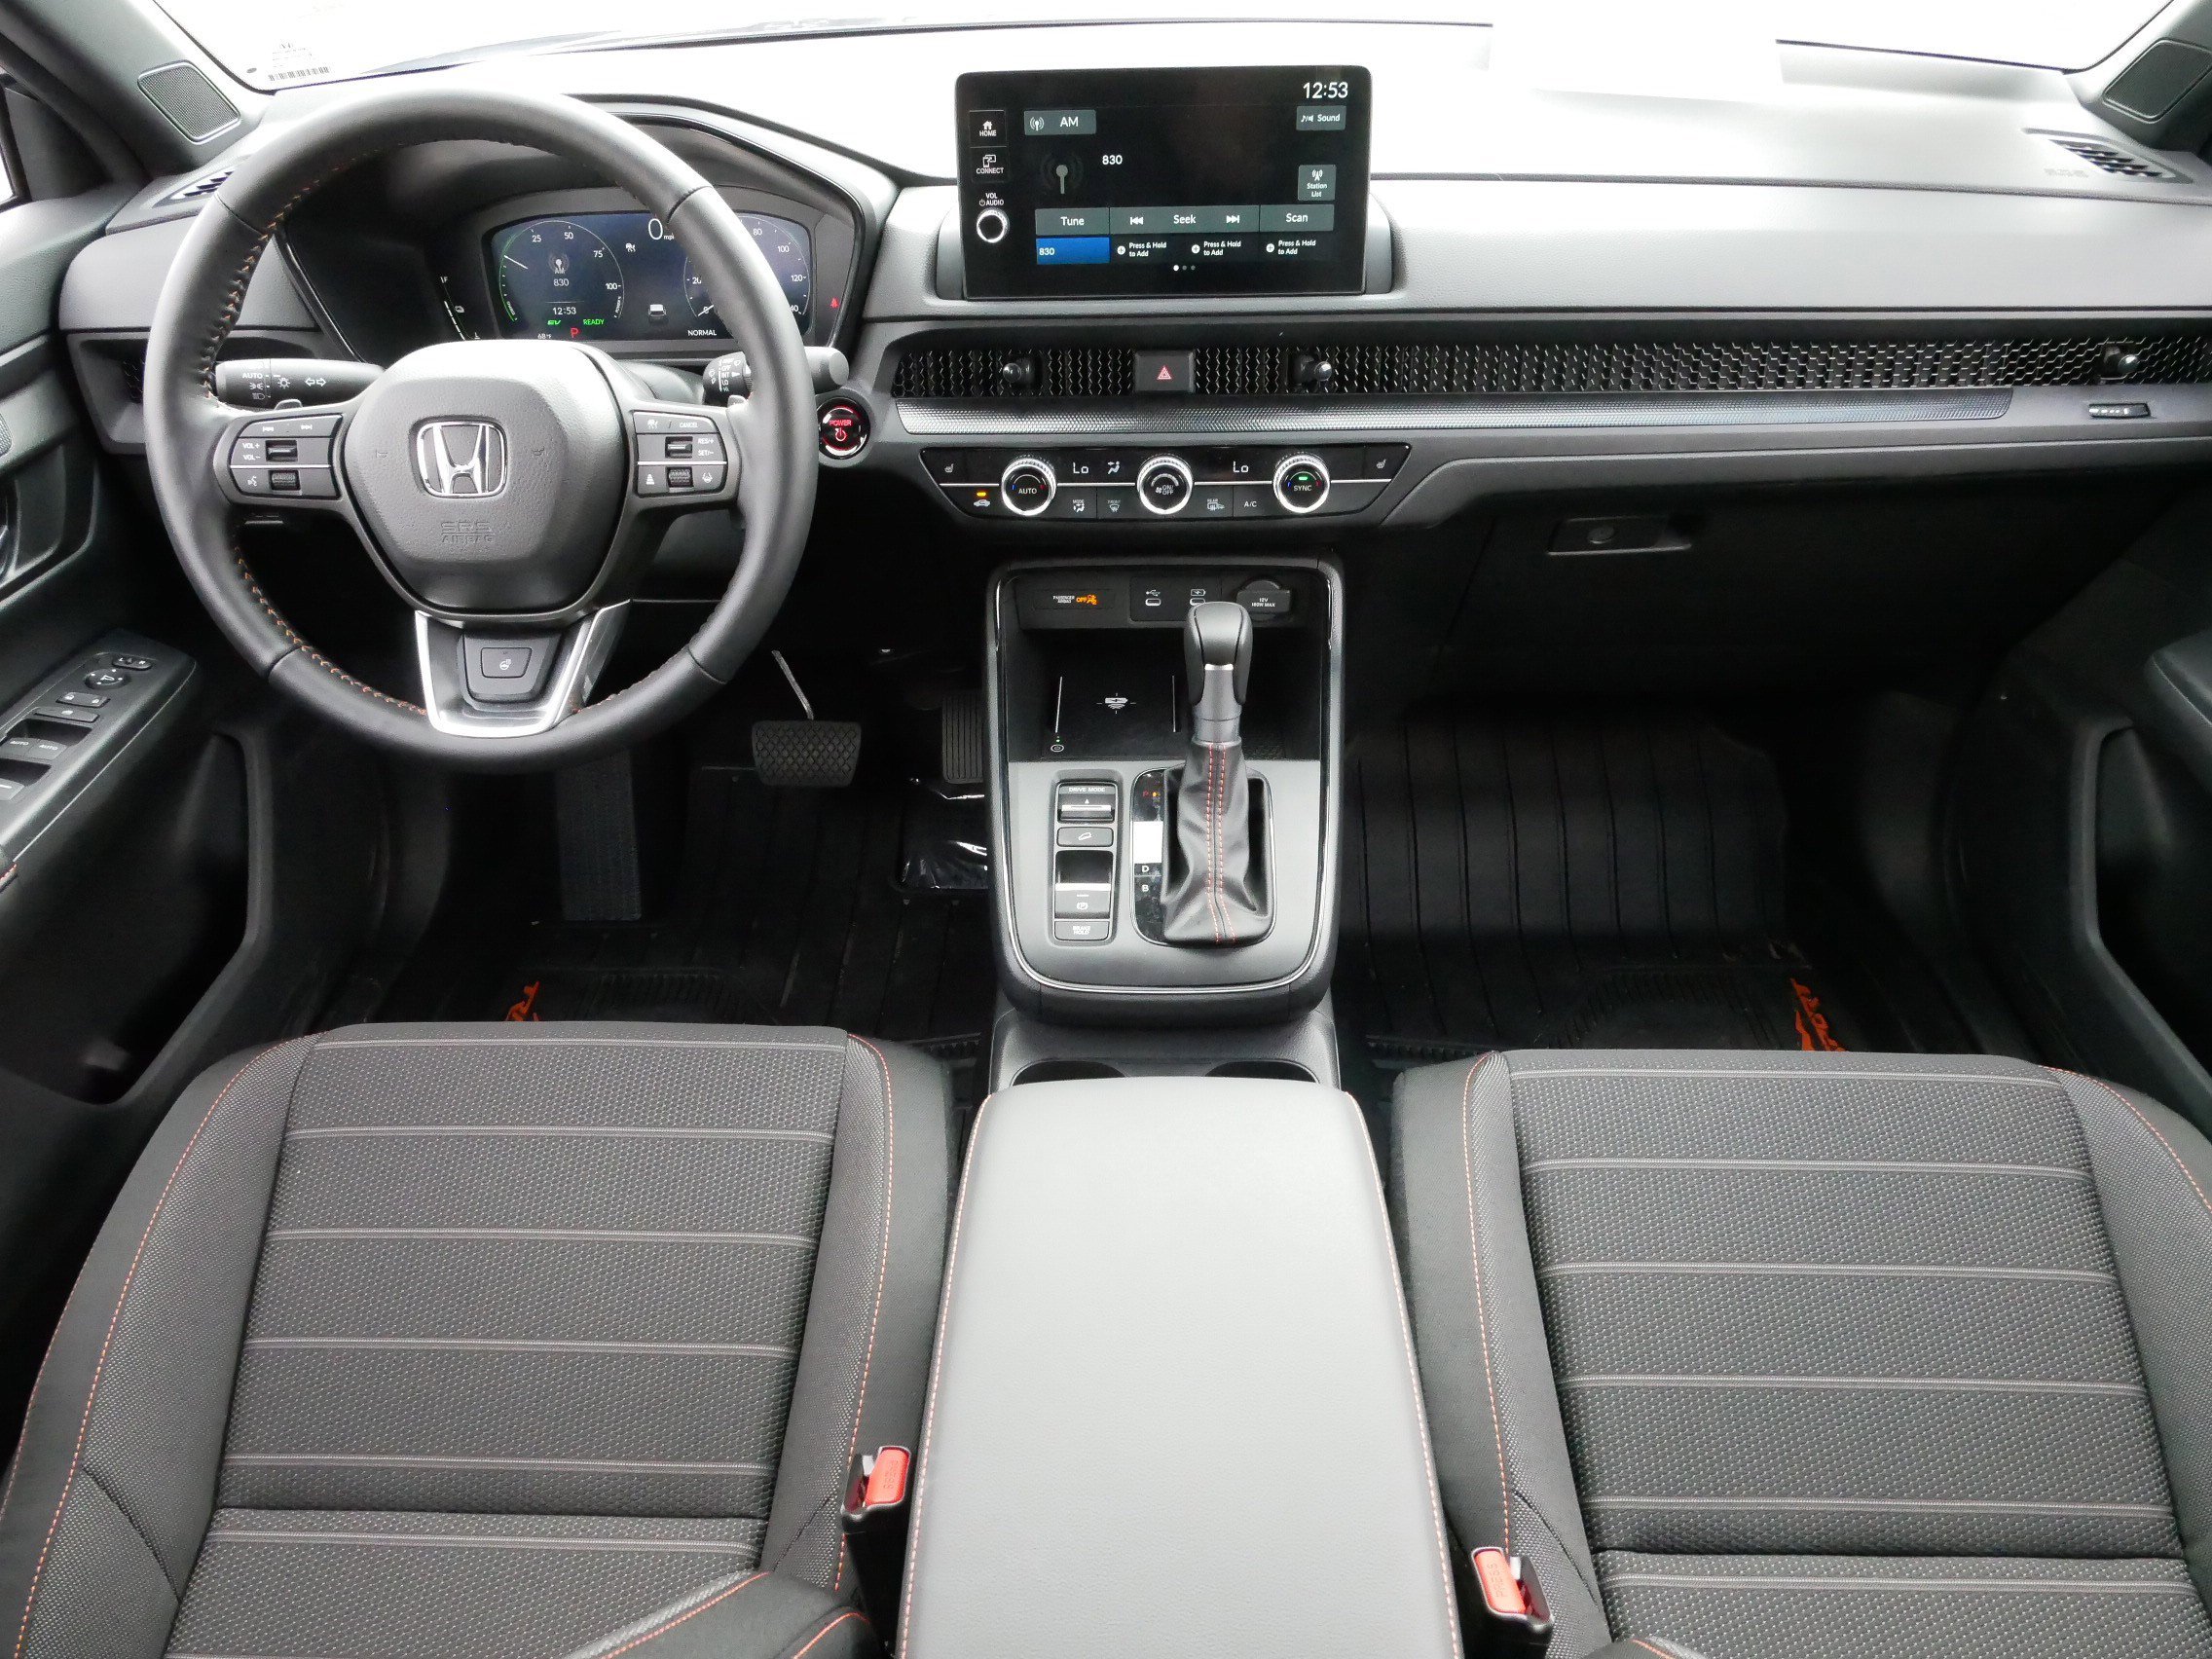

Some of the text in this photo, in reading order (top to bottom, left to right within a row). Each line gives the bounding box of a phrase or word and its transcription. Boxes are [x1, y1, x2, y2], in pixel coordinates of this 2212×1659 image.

[1303, 81, 1348, 99] 12:53
[1060, 116, 1079, 128] AM
[1317, 114, 1341, 123] Sound
[1102, 154, 1123, 166] 830
[1060, 216, 1085, 226] Tune
[1173, 214, 1197, 224] Seek
[1285, 212, 1309, 223] Scan
[647, 218, 663, 240] 0
[1039, 247, 1055, 256] 830
[552, 307, 576, 315] 12:53
[571, 327, 579, 338] P
[1141, 865, 1150, 873] D
